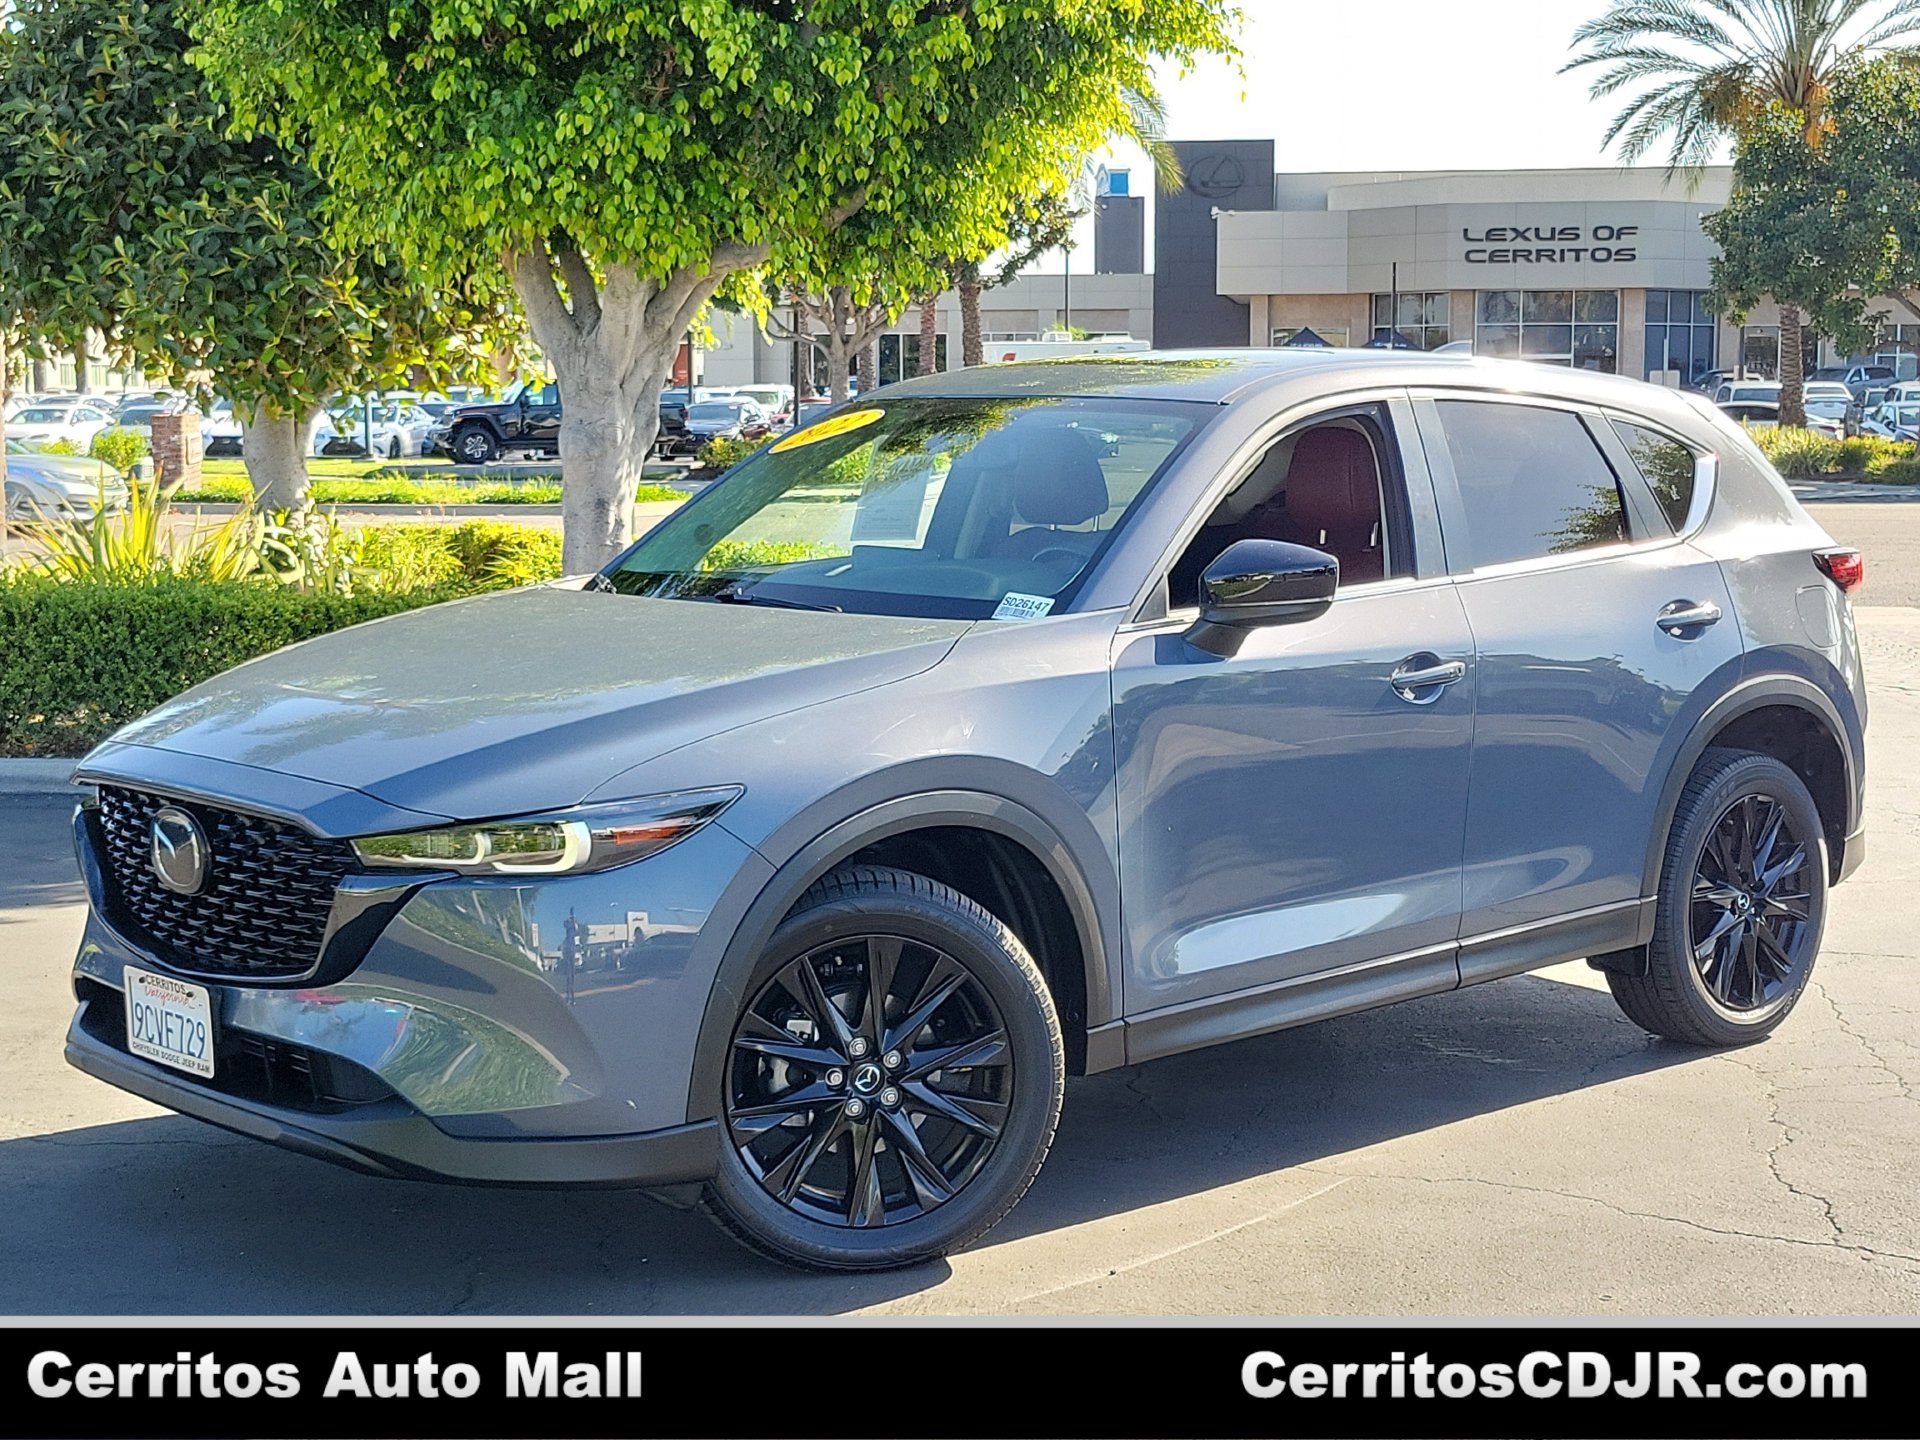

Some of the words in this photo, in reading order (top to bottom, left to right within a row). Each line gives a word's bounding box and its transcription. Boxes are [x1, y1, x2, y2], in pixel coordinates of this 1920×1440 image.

[1462, 226, 1581, 243] LEXUS
[1592, 225, 1639, 242] OF
[1464, 247, 1637, 264] CERRITOS
[1003, 596, 1050, 612] SD26147
[145, 974, 187, 996] CERRITOS
[134, 1001, 206, 1060] 9CVF729
[161, 1051, 180, 1064] DODGE
[182, 1057, 196, 1068] JEEP
